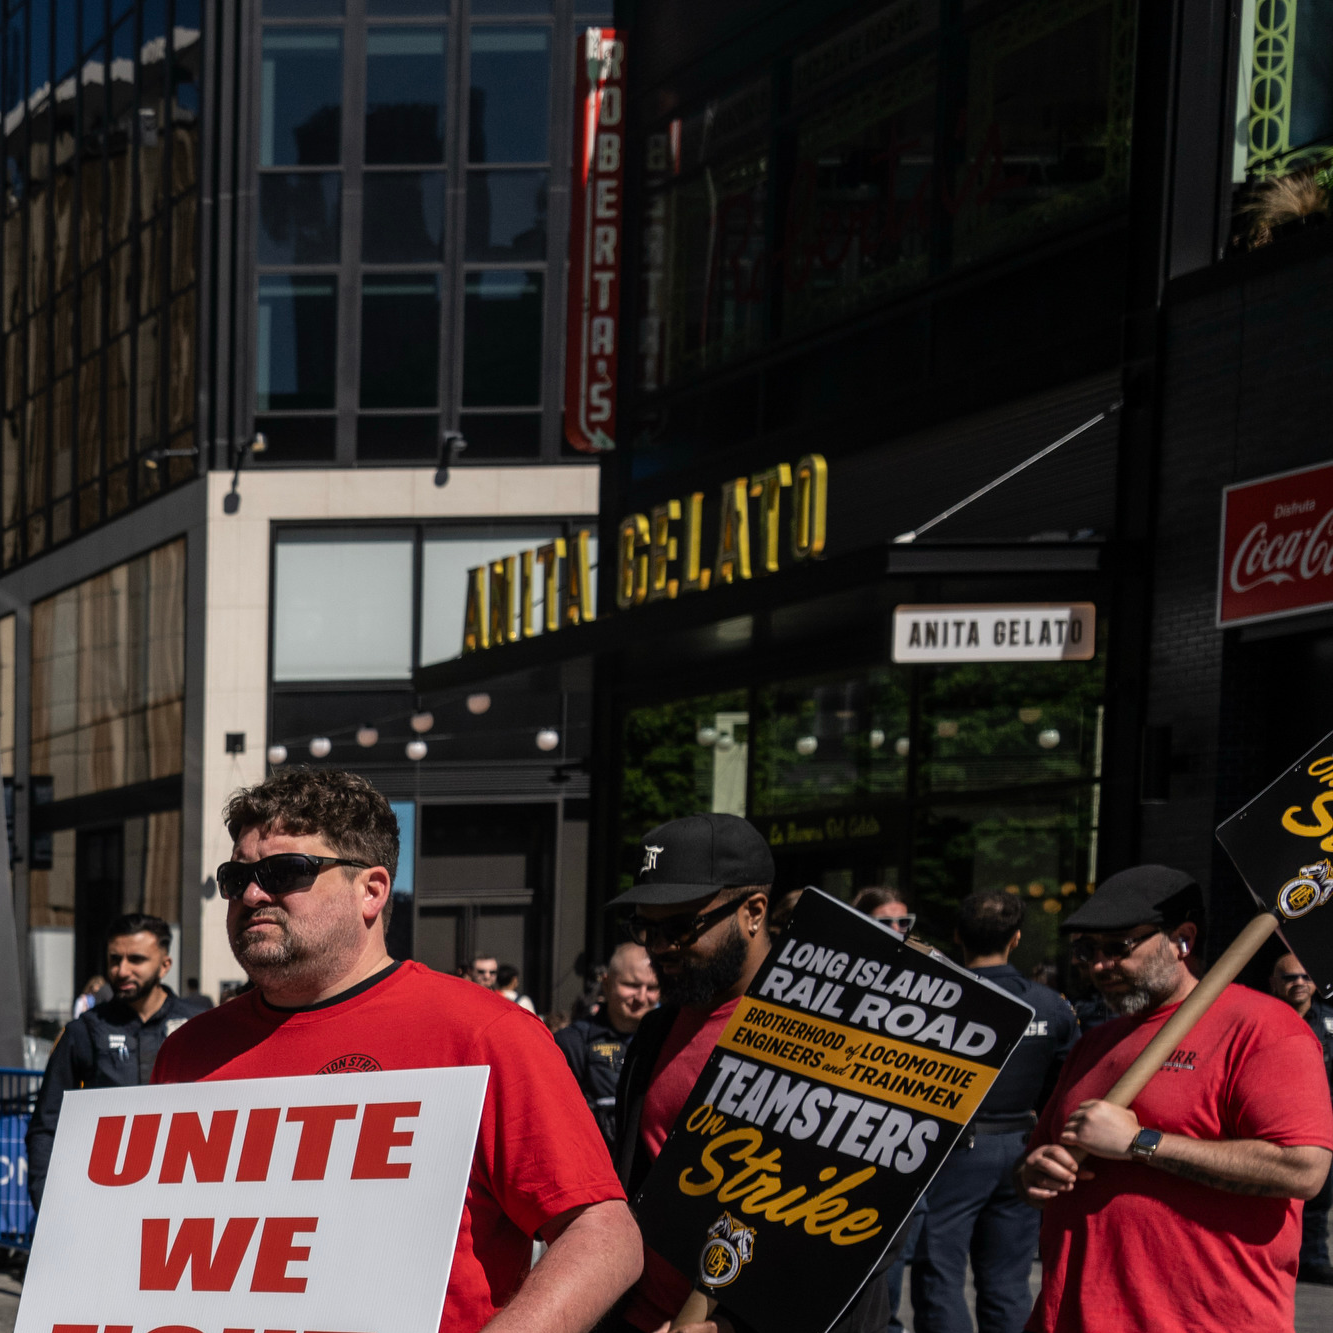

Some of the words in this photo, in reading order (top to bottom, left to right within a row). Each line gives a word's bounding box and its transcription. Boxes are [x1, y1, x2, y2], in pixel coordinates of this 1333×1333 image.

[589, 38, 625, 424] ROBERTA'S
[1274, 499, 1316, 519] Disfruta
[463, 529, 597, 653] ANITA
[617, 453, 828, 609] GELATO
[908, 619, 981, 648] ANITA
[993, 618, 1084, 646] GELATO
[758, 967, 852, 1018] RAIL
[849, 994, 997, 1056] ROAD
[777, 939, 849, 980] LONG
[847, 957, 963, 1009] ISLAND
[731, 1026, 825, 1068] ENGINEERS
[820, 1062, 849, 1078] and
[848, 1062, 963, 1110] TRAINMEN
[743, 1006, 847, 1051] BROTHERHOOD
[844, 1040, 862, 1058] of
[859, 1042, 978, 1090] LOCOMOTIVE
[1167, 1049, 1196, 1064] IRR
[87, 1101, 422, 1187] UNITE
[704, 1055, 940, 1174] TEAMSTERS
[679, 1126, 882, 1246] Strike
[139, 1217, 319, 1293] WE
